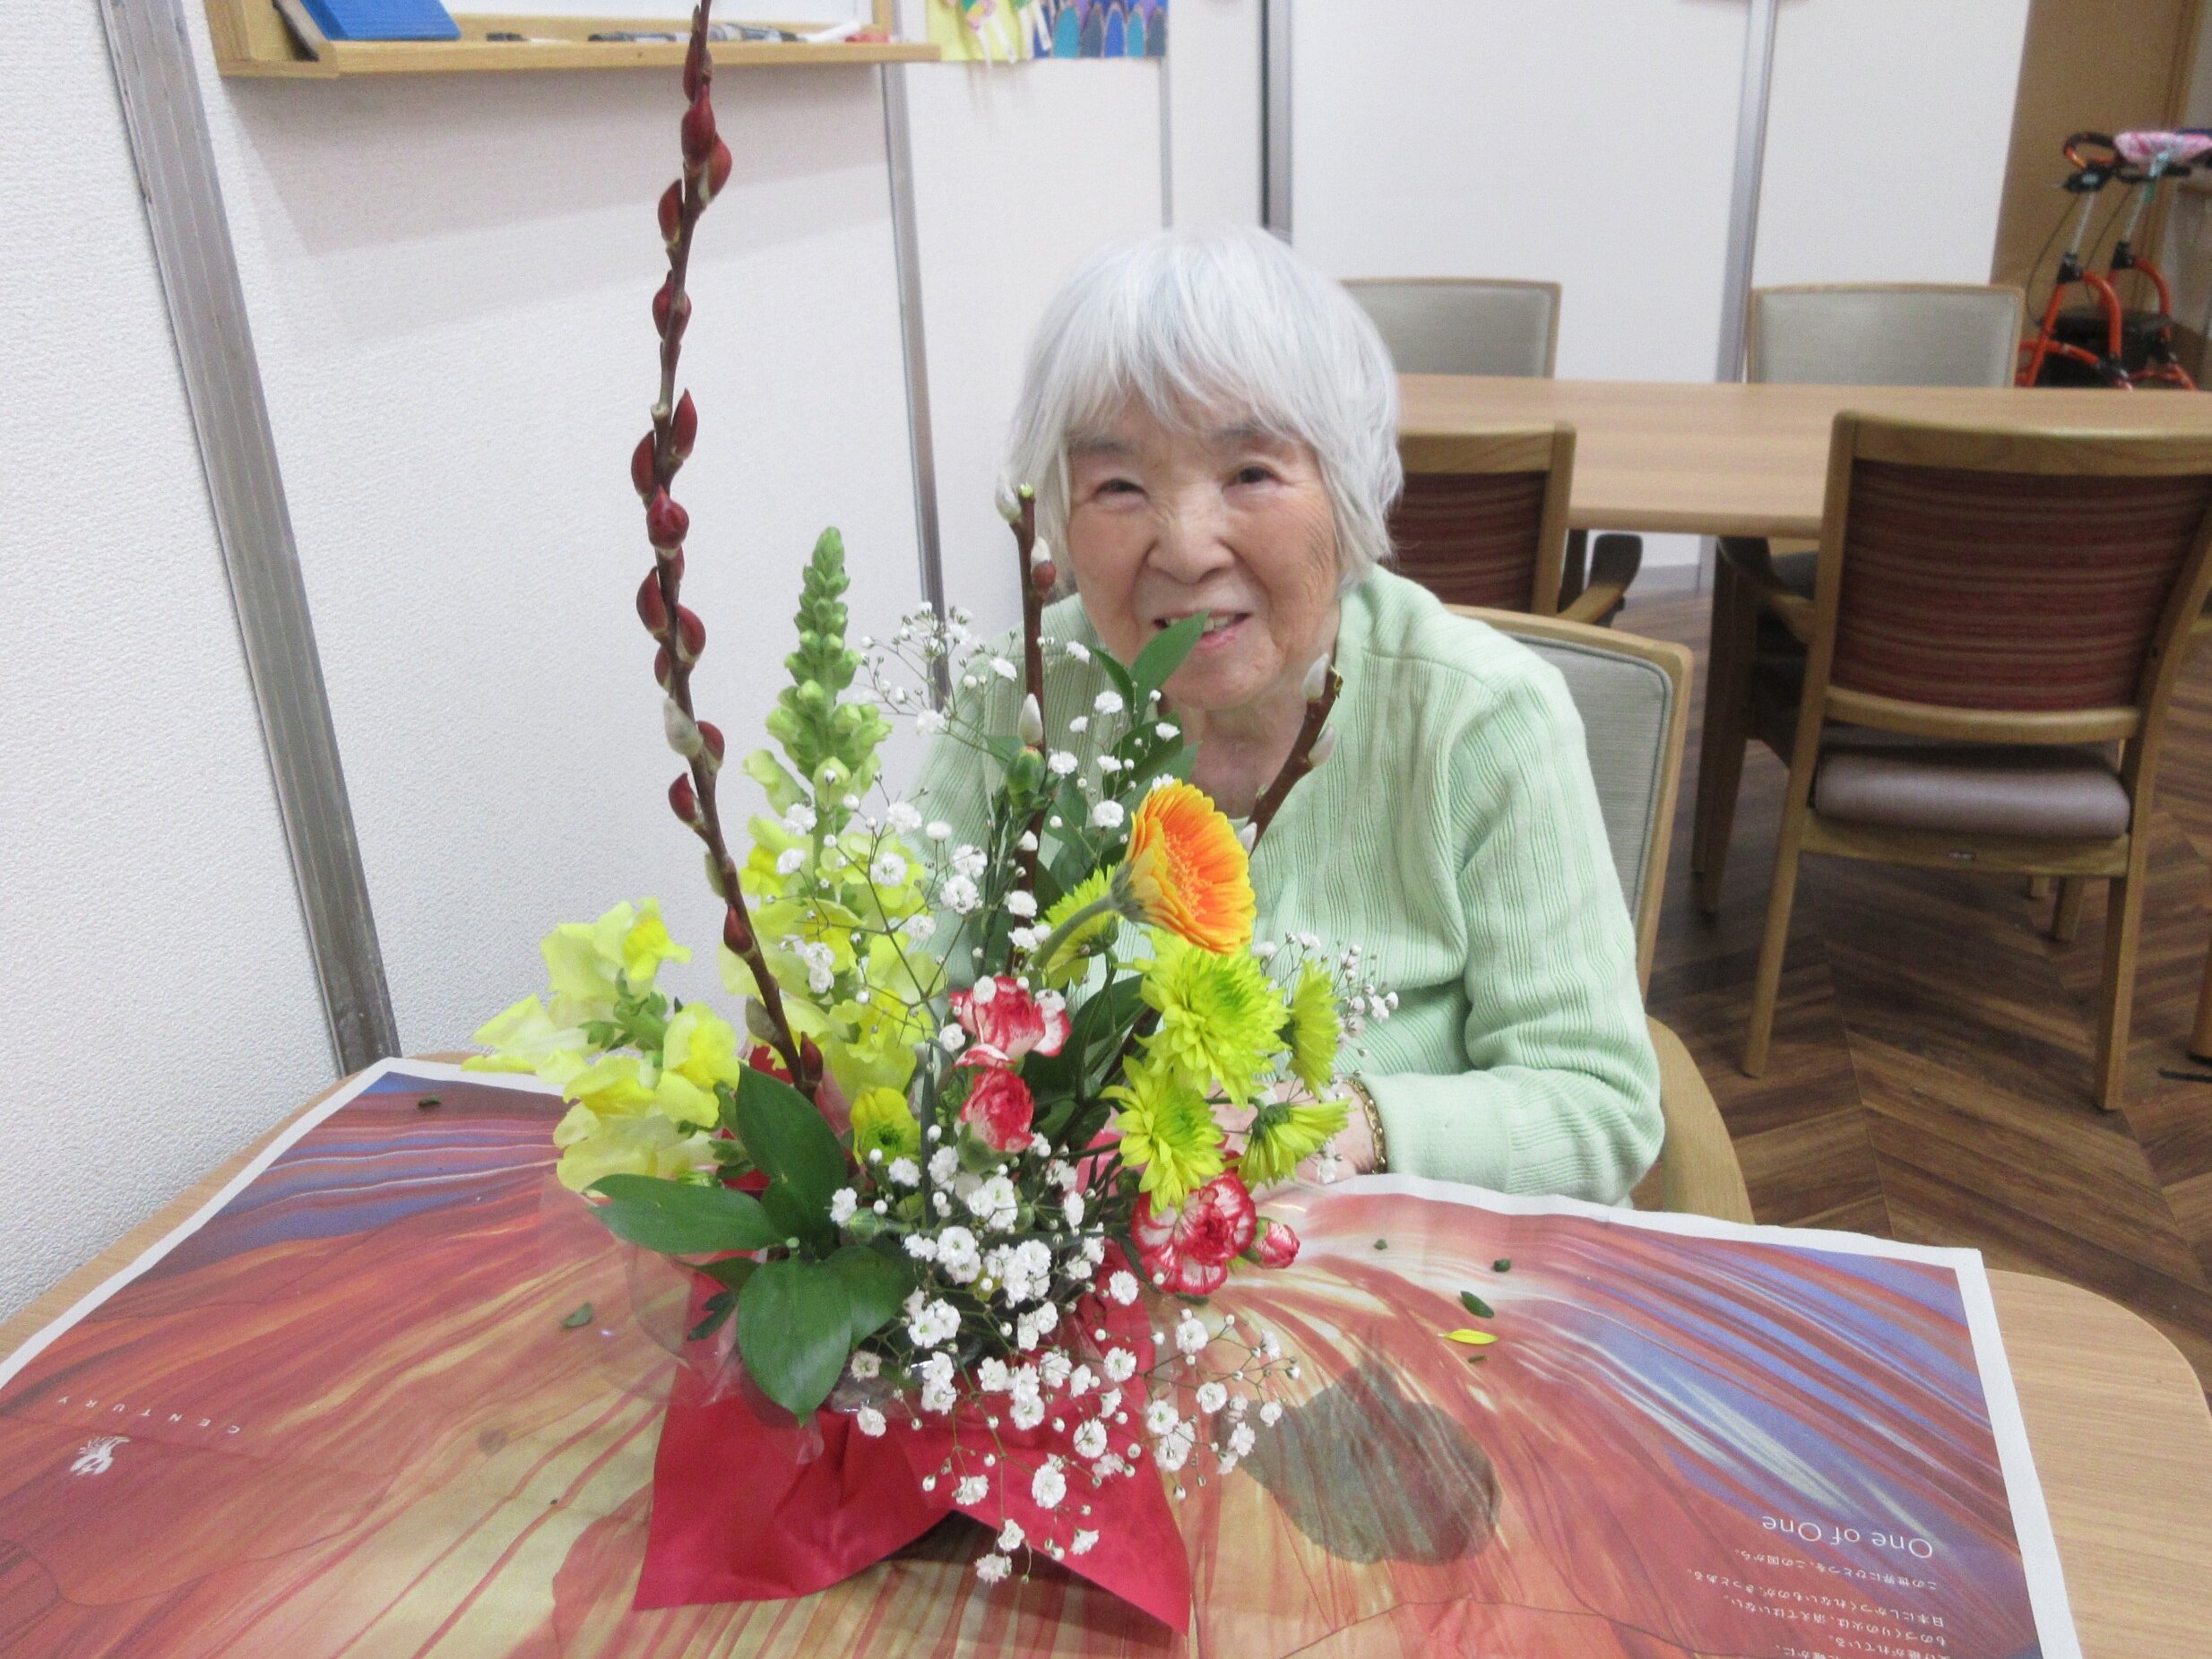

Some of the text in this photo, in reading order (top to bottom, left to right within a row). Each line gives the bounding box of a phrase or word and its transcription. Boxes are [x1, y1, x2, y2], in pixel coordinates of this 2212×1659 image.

[58, 1395, 240, 1434] CENTURY
[1762, 1516, 1933, 1559] One of One
[1735, 1549, 1937, 1590] この世界にひとつを、この国から。
[1687, 1568, 1944, 1628] 日本にしかつくれないものが、きっとある。
